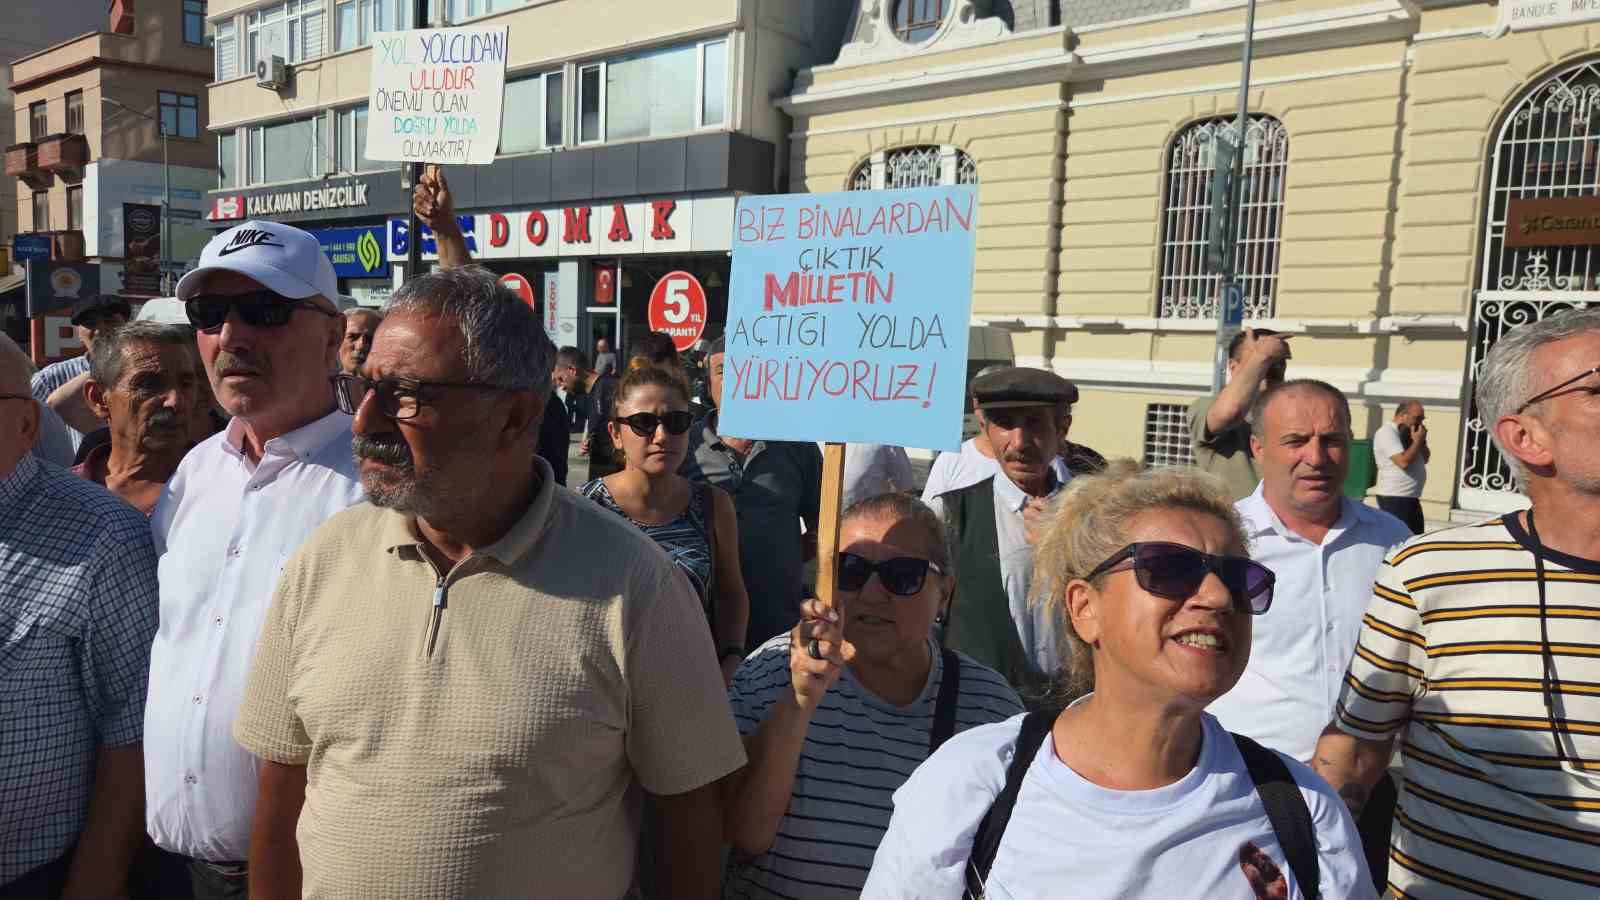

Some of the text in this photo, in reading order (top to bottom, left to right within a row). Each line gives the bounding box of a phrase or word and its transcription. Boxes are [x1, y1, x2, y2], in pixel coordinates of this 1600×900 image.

[380, 32, 503, 65] YOL YOLCUDAN
[410, 66, 475, 90] ULUDUR
[433, 90, 469, 113] OLAN
[444, 115, 478, 135] YOLDA
[248, 180, 368, 215] KALKAVAN DENİZCİLİK
[489, 199, 677, 248] DOMAK
[739, 192, 974, 242] BİZ BİNALARDAN
[230, 229, 275, 246] NIKE
[798, 245, 885, 272] ÇIKTIK
[664, 279, 690, 323] 5
[1228, 287, 1240, 322] P
[731, 311, 947, 350] AÇTIĞI YOLDA
